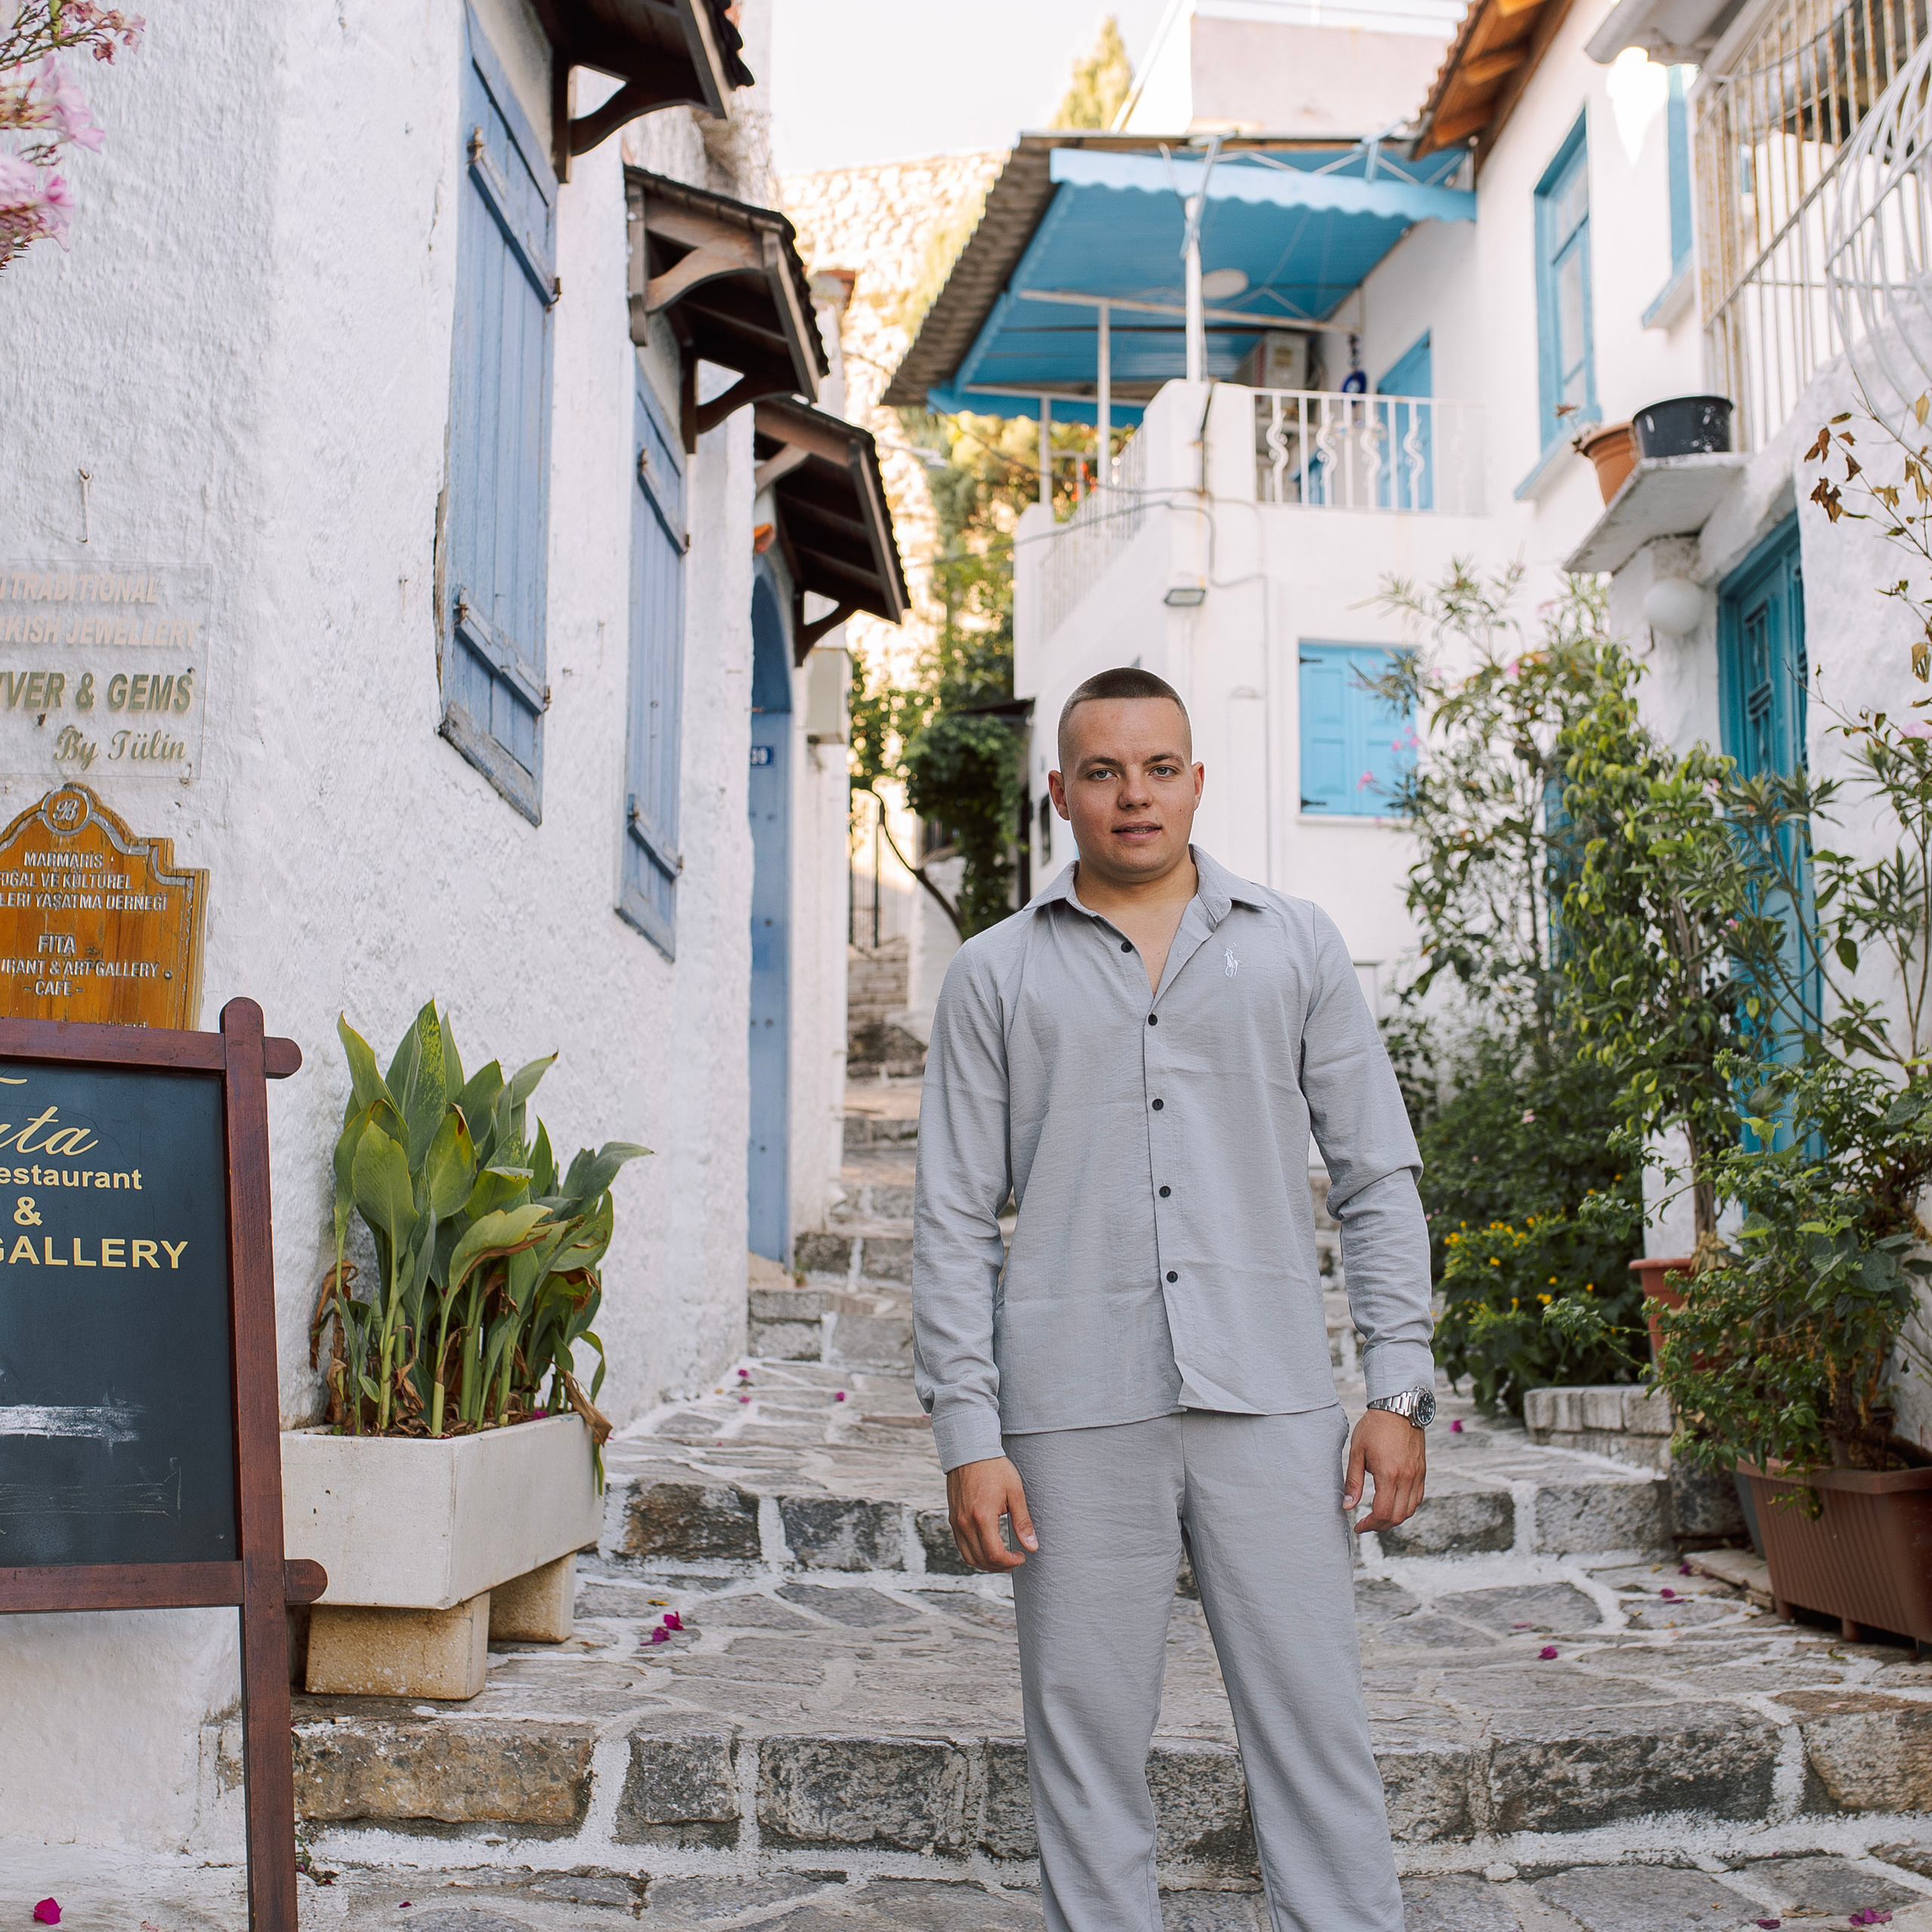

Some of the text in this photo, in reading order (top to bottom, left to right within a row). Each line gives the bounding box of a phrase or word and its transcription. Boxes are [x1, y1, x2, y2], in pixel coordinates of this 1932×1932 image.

[66, 617, 201, 646] JEWELLERY
[75, 672, 95, 709] &
[107, 673, 193, 712] GEMS
[54, 725, 187, 771] By Tülin
[23, 850, 103, 869] MARMARİS
[41, 871, 59, 888] VE
[63, 869, 133, 889] KÜLTÜREL
[35, 891, 103, 911] YAŞATMA
[106, 891, 168, 911] DERNEĞİ
[38, 934, 76, 954] FITA
[49, 958, 60, 976] &
[63, 959, 92, 977] ART
[95, 960, 160, 978] GALLERY
[35, 979, 72, 996] CAFE
[13, 1195, 43, 1226] &
[0, 1235, 189, 1269] ALLERY
